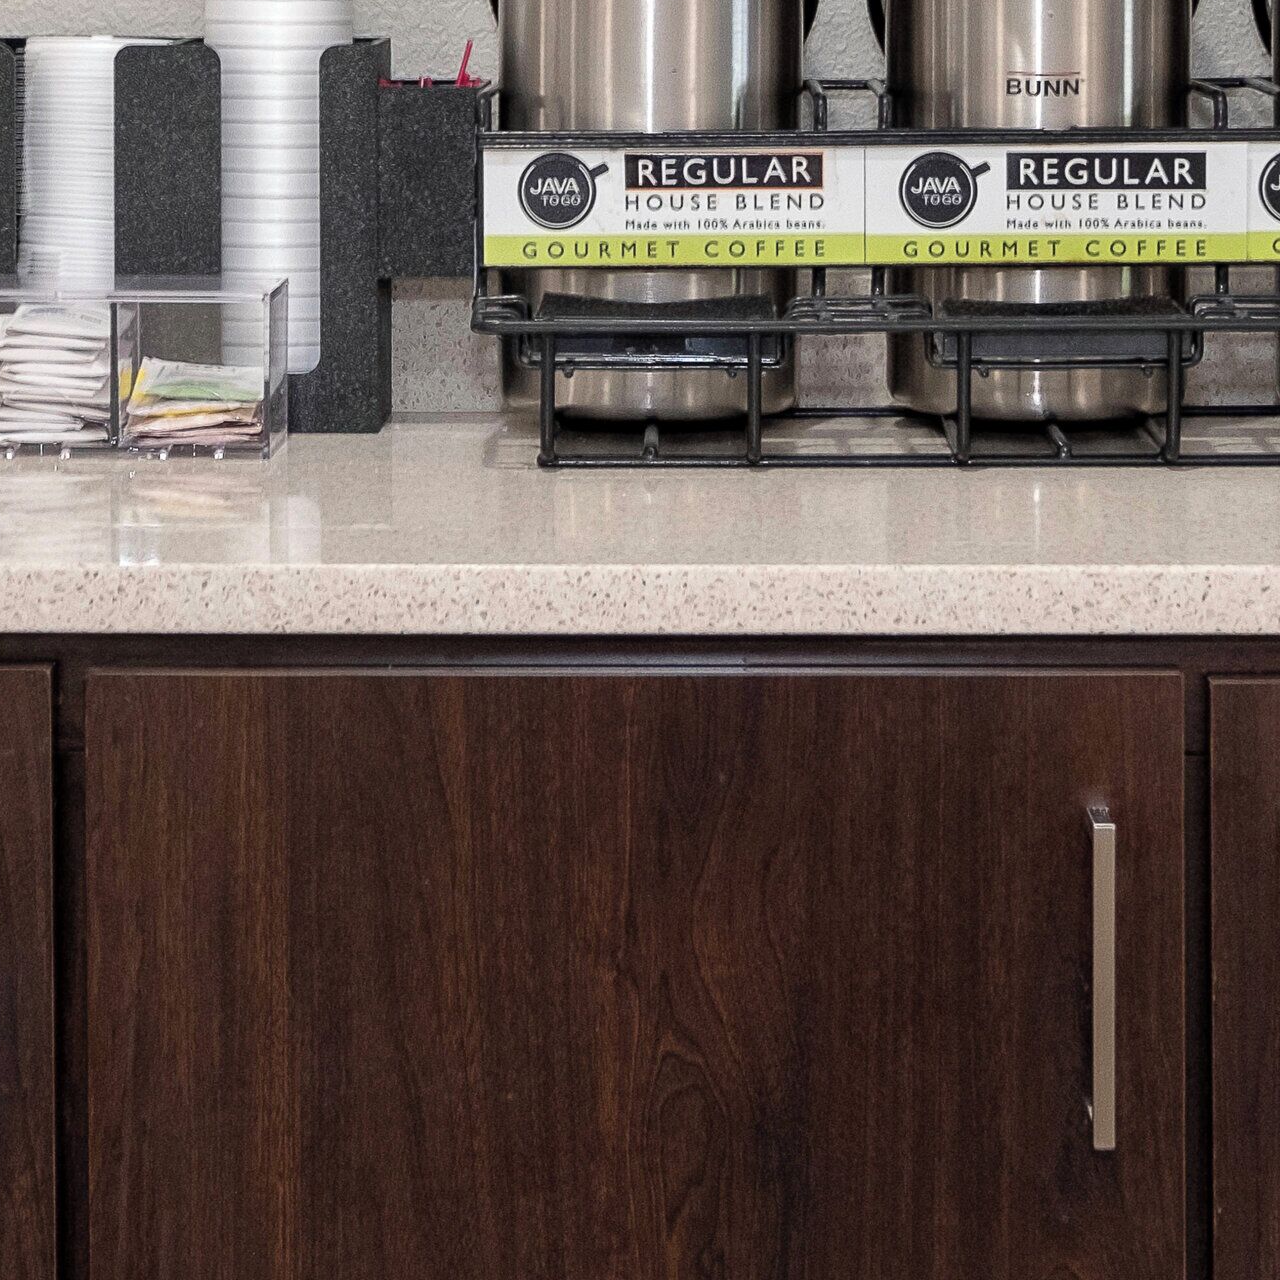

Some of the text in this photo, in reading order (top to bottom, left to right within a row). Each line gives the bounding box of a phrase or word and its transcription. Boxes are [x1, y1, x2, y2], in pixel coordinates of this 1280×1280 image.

[1006, 78, 1079, 97] BUNN
[638, 156, 811, 186] REGULAR
[1020, 157, 1194, 186] REGULAR
[530, 177, 580, 195] JAVA
[910, 176, 961, 194] JAVA
[625, 193, 824, 212] HOUSE BLEND
[1007, 193, 1206, 210] HOUSE BLEND
[625, 219, 658, 230] Made
[664, 219, 690, 230] with
[697, 219, 728, 230] 100%
[733, 219, 780, 230] Arabica
[1007, 219, 1038, 229] Made
[1044, 219, 1071, 229] with
[1079, 218, 1109, 229] 100%
[1114, 218, 1161, 229] Arabica
[523, 240, 825, 258] GOURMET COFFEE
[903, 240, 1207, 257] GOURMET COFFEE
